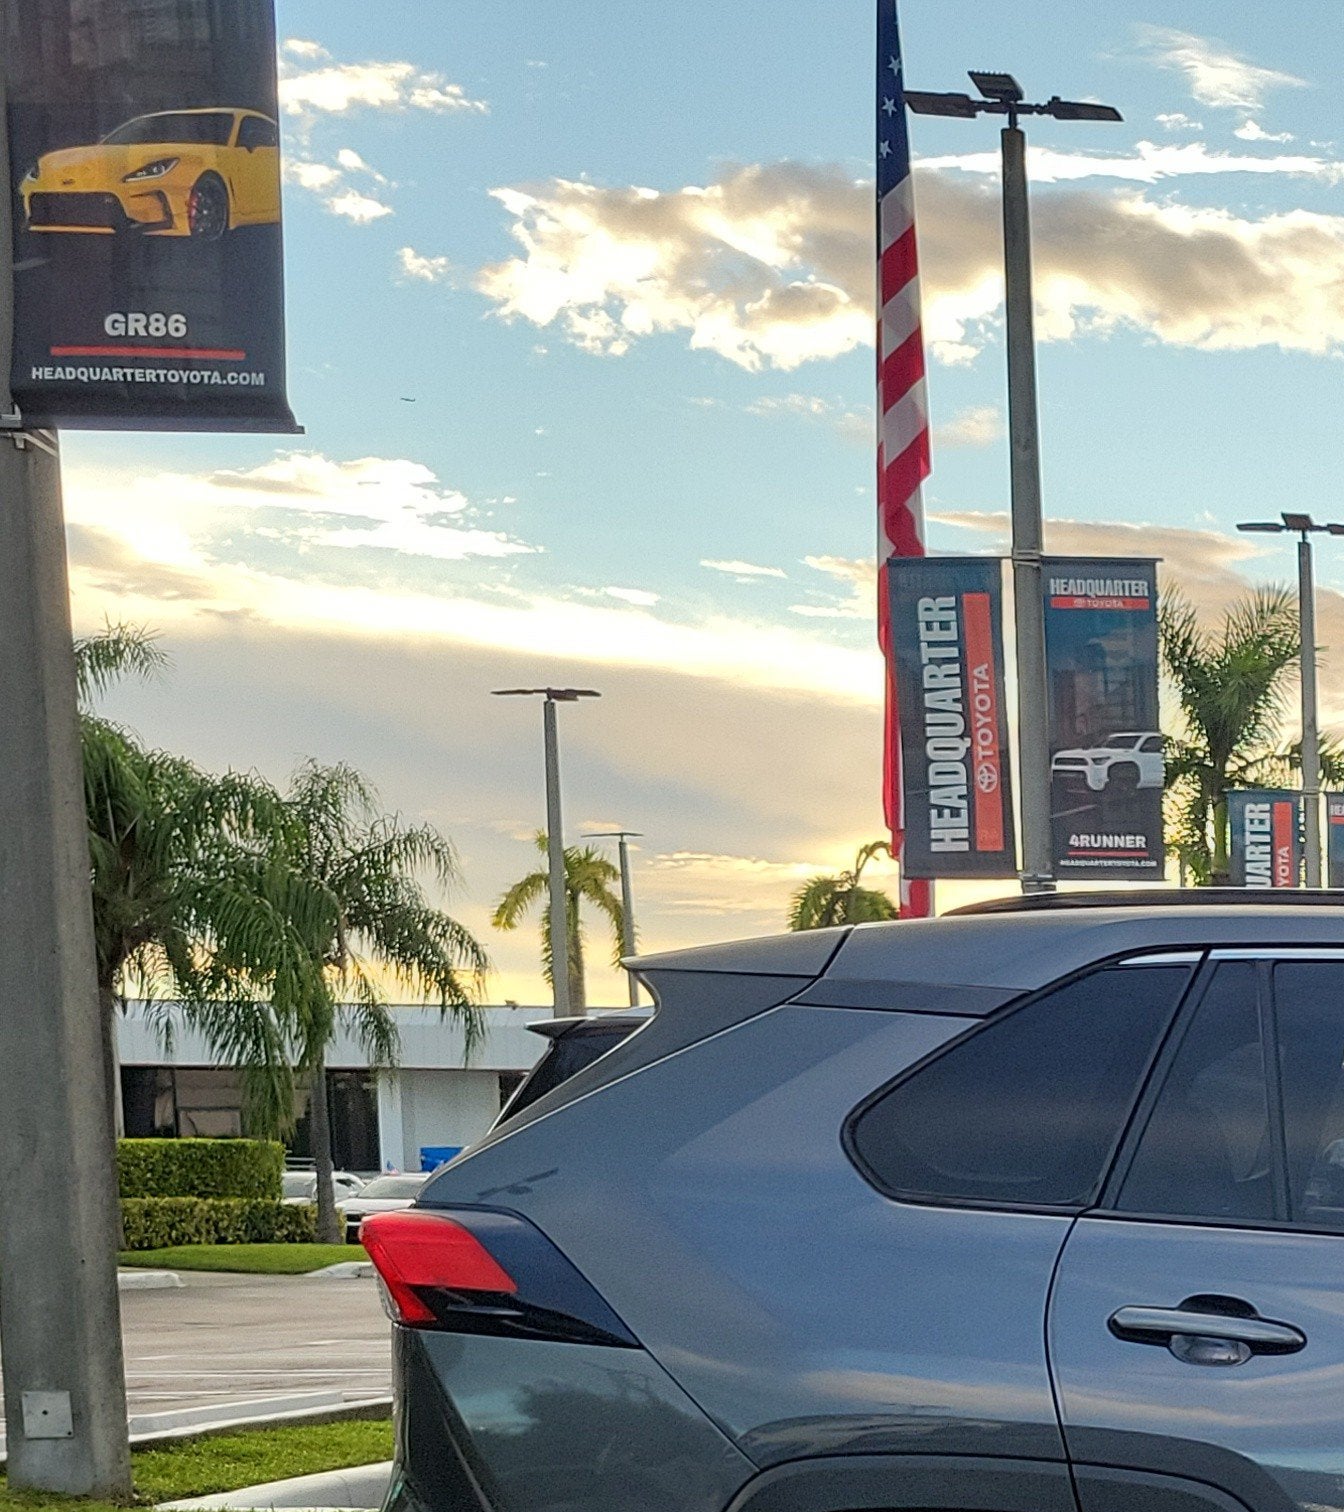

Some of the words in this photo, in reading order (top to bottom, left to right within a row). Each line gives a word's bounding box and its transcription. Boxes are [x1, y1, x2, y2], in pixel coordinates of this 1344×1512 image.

[104, 312, 187, 338] GR86
[31, 366, 265, 386] HEADQUARTERTOYOTA.COM
[1050, 578, 1149, 598] HEADQUARTER
[1087, 599, 1125, 608] TOYOTA
[973, 663, 996, 761] TOYOTA
[917, 596, 971, 852] HEADQUARTER
[1069, 834, 1147, 848] 4RUNNER
